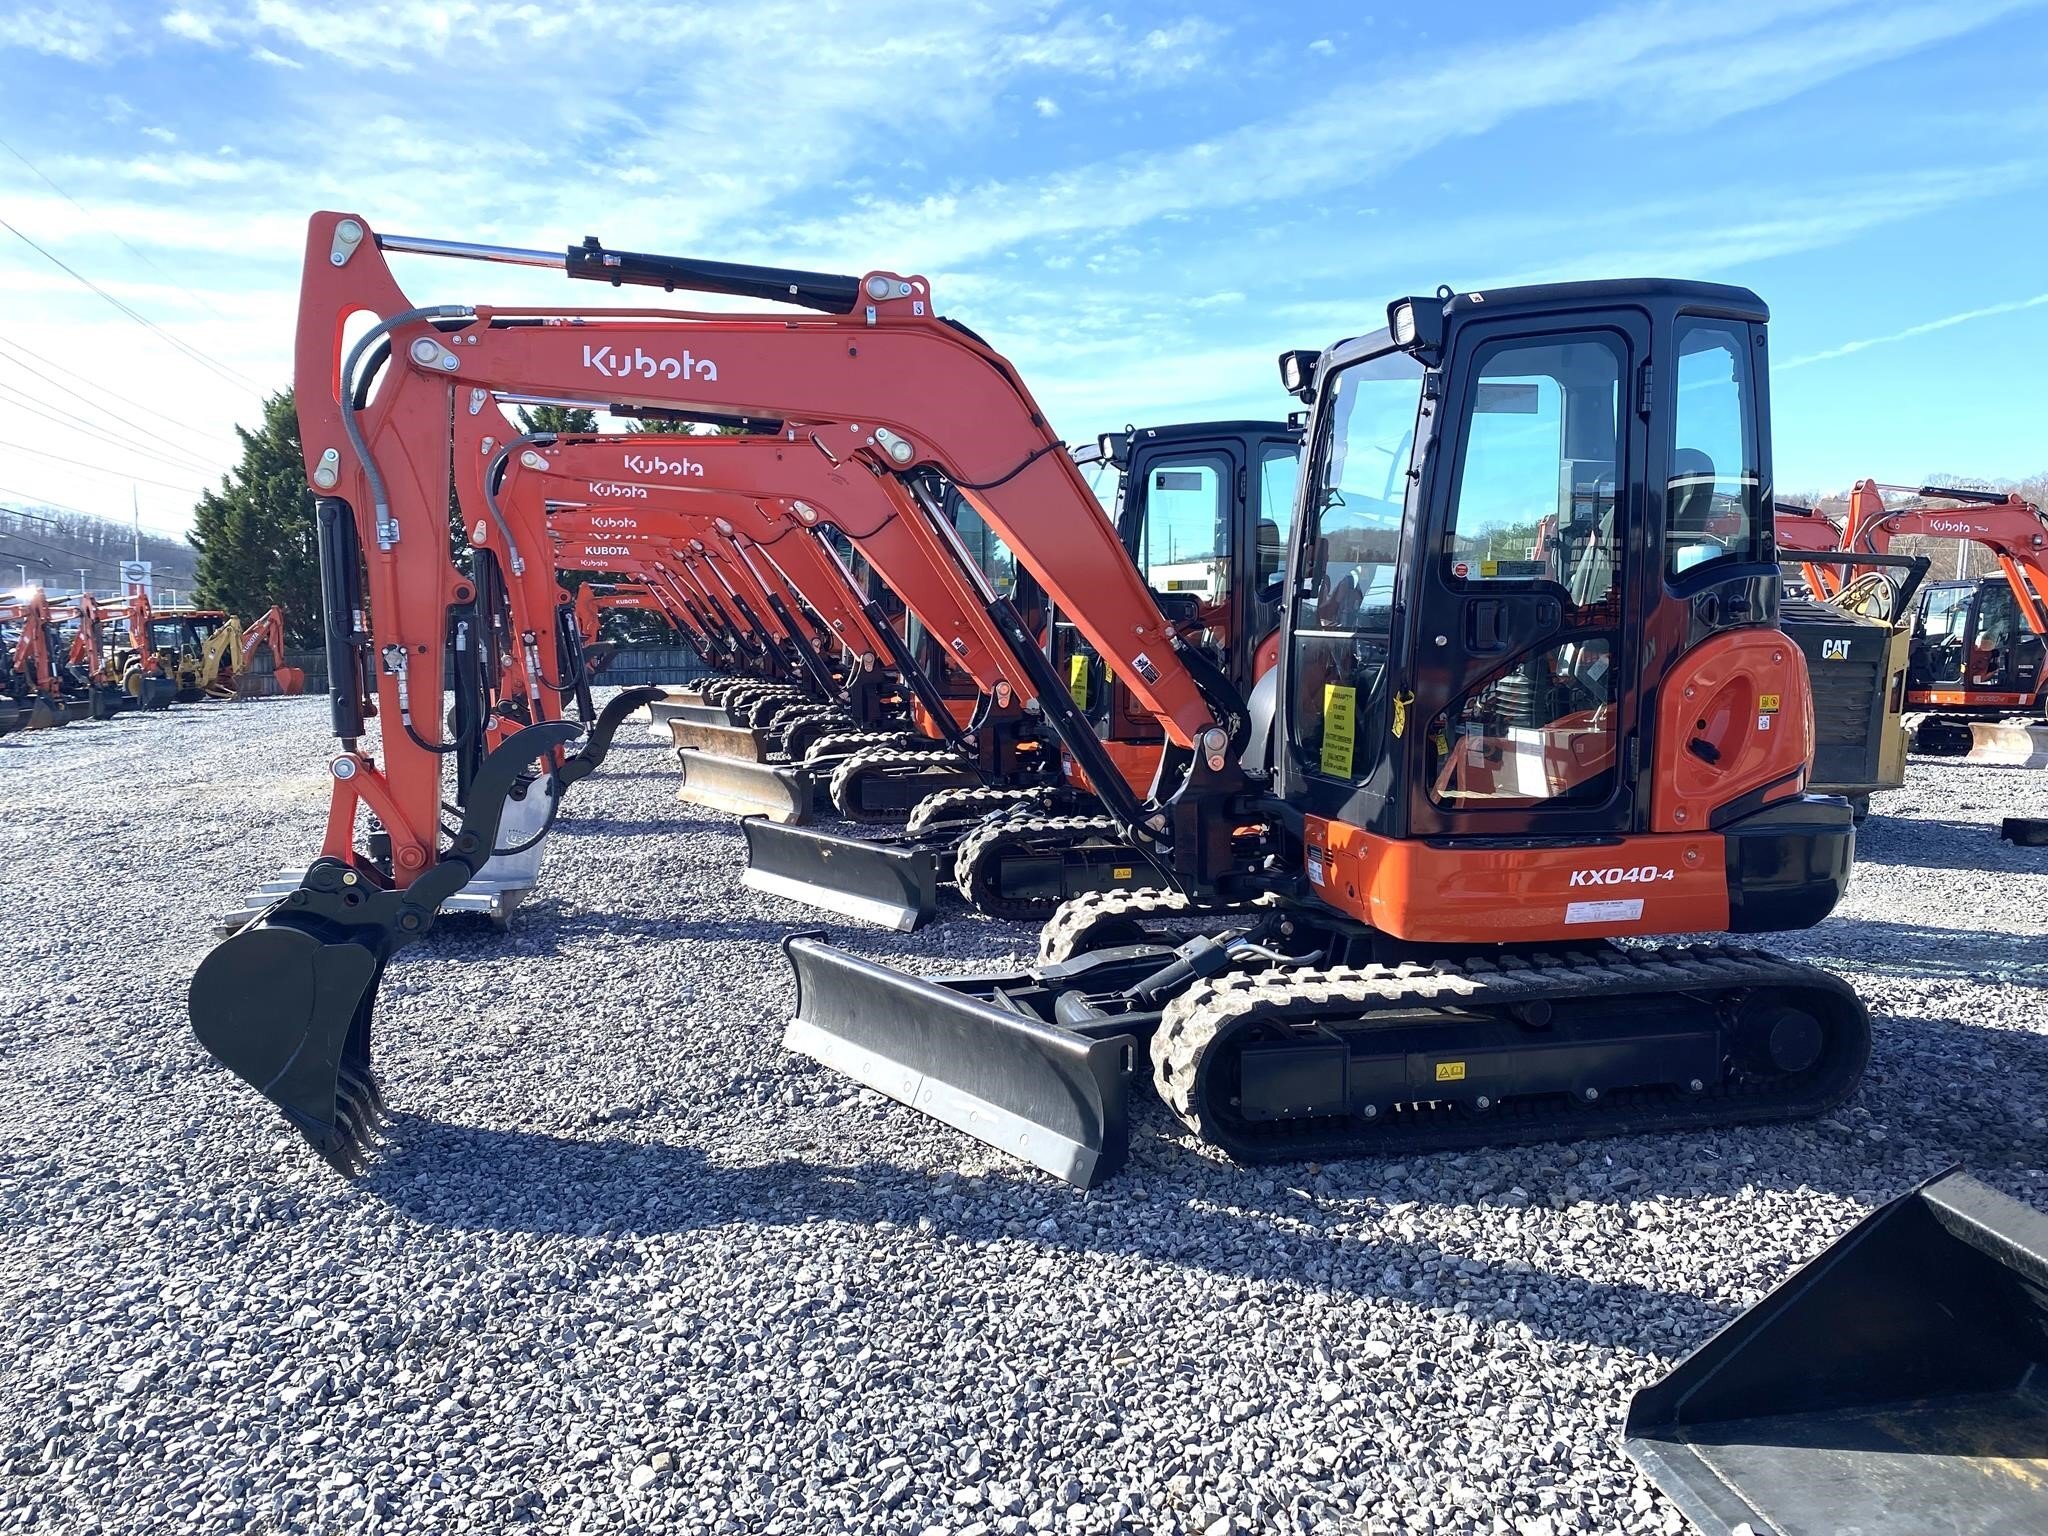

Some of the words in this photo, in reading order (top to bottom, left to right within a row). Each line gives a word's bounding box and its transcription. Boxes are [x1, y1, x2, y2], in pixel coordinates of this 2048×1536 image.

[583, 345, 718, 381] Kubota
[624, 455, 704, 477] Kubota
[589, 482, 648, 499] Kubota
[591, 517, 637, 528] Kubota
[1930, 519, 1970, 533] Kubota
[585, 546, 630, 555] KUBOTA
[580, 559, 608, 567] Kubota
[1822, 639, 1851, 660] CAT
[1569, 866, 1674, 887] KX040-4
